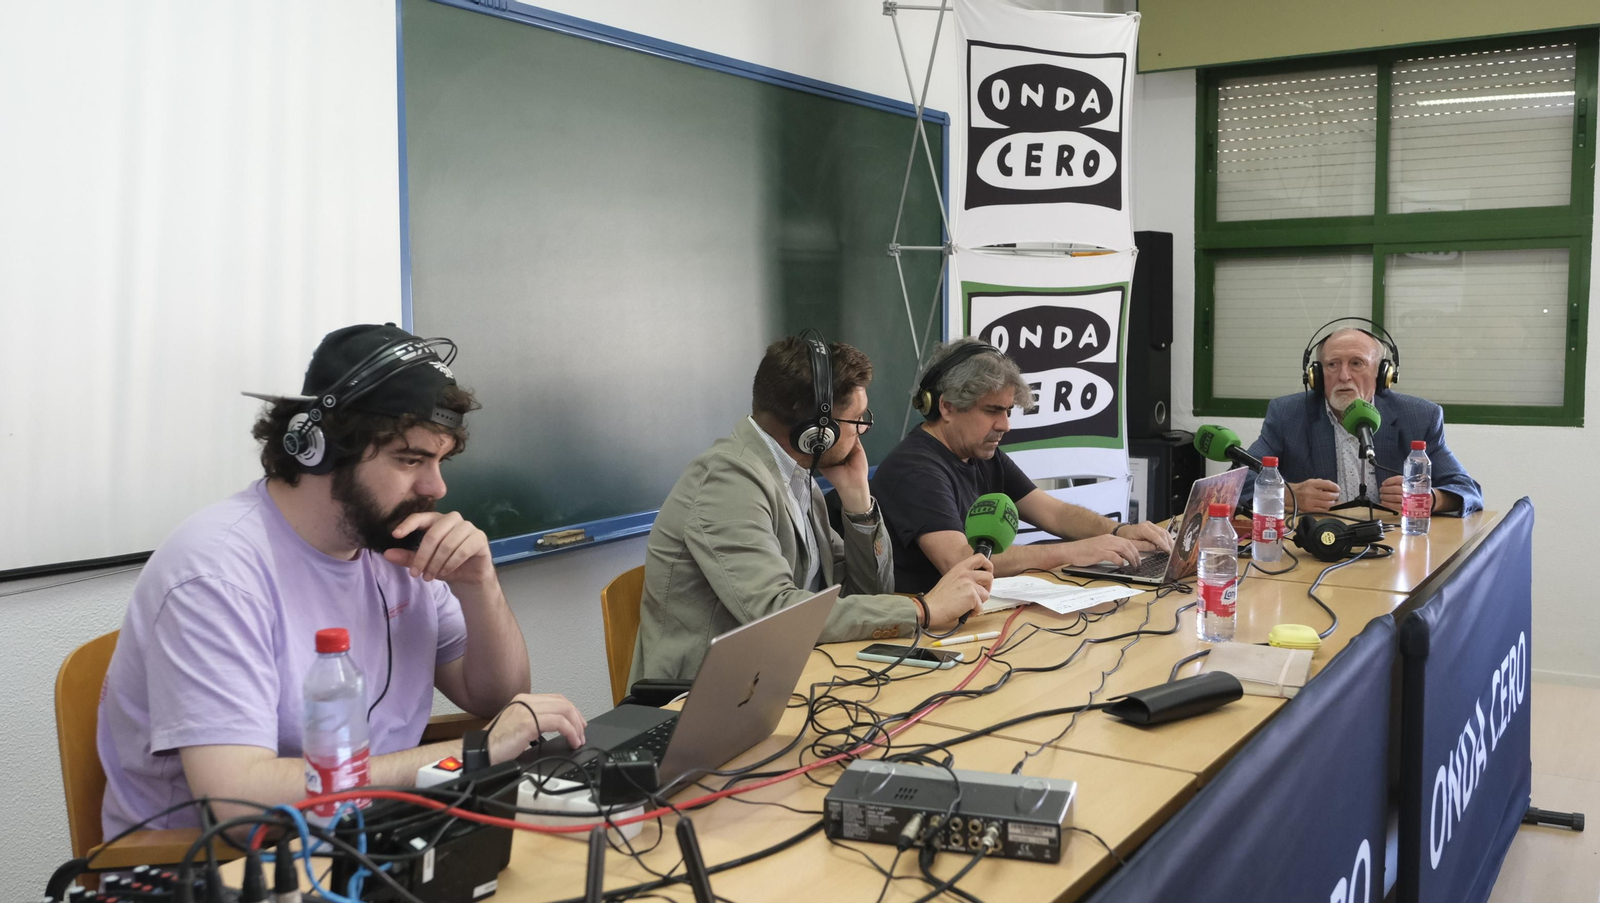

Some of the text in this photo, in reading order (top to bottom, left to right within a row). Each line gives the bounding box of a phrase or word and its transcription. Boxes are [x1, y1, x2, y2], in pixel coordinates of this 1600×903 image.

[990, 79, 1101, 114] ONDA
[997, 142, 1100, 178] CERO
[990, 323, 1098, 354] ONDA
[1008, 380, 1098, 417] ERO
[1430, 630, 1526, 870] ONDA CERO
